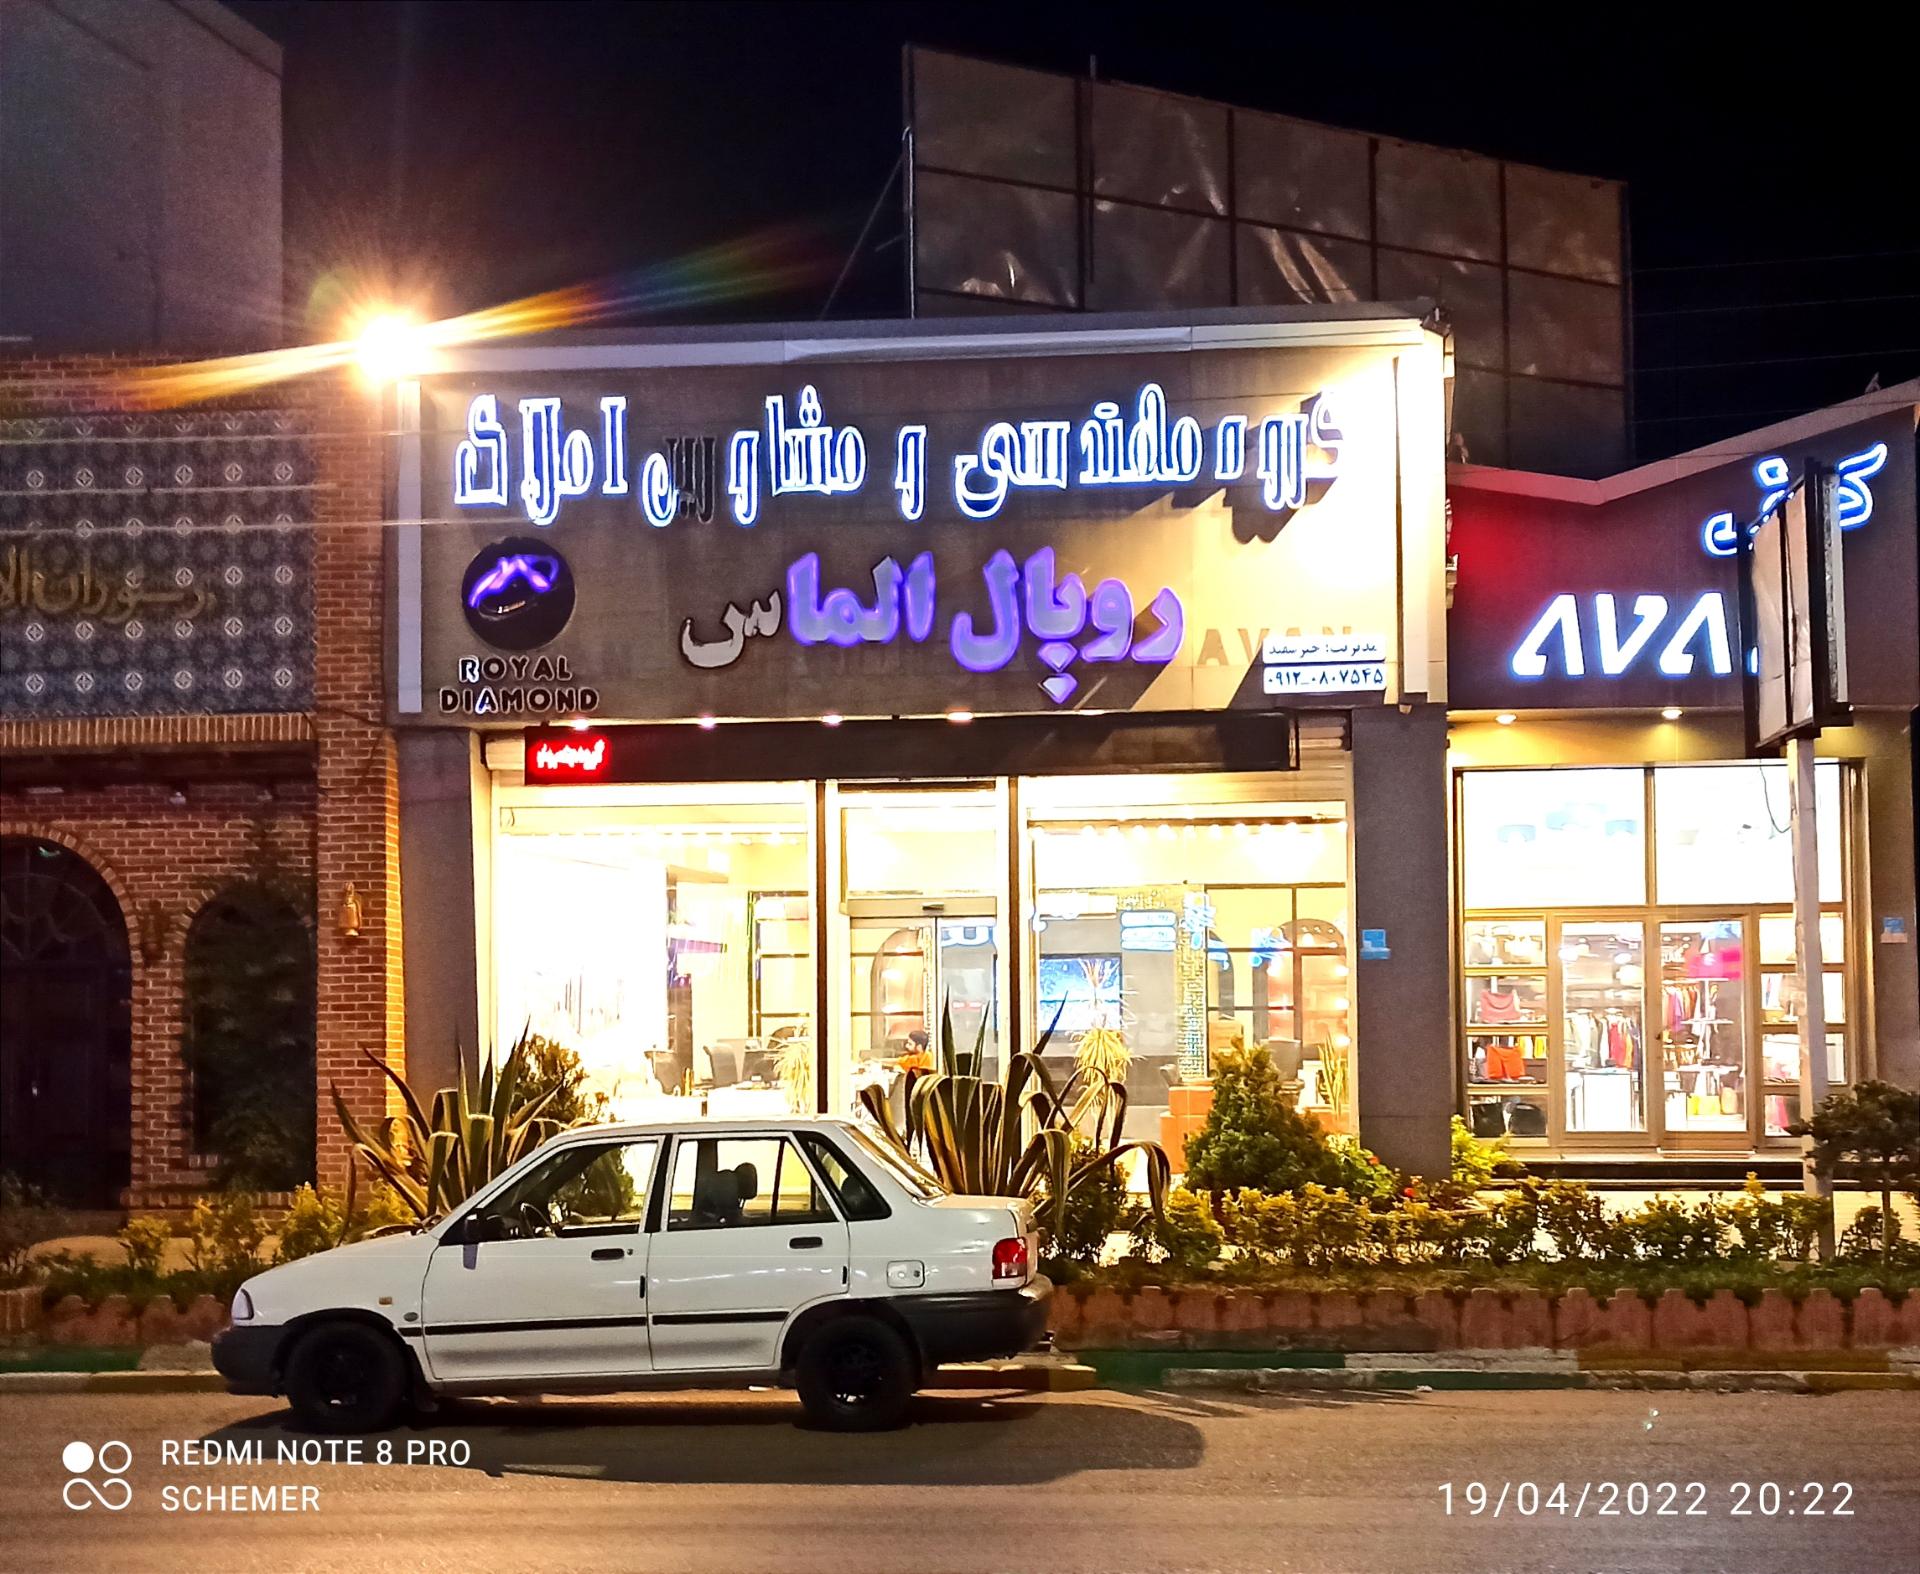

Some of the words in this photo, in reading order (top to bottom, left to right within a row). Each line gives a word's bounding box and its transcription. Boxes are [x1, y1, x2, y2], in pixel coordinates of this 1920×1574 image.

[454, 394, 629, 526] املاک
[895, 423, 928, 521] و
[954, 382, 1204, 519] مهندسی
[680, 551, 937, 669] الماس
[951, 546, 1185, 704] رویال
[1512, 591, 1758, 678] AVA
[440, 687, 599, 715] DIAMOND
[459, 655, 573, 683] ROYAL
